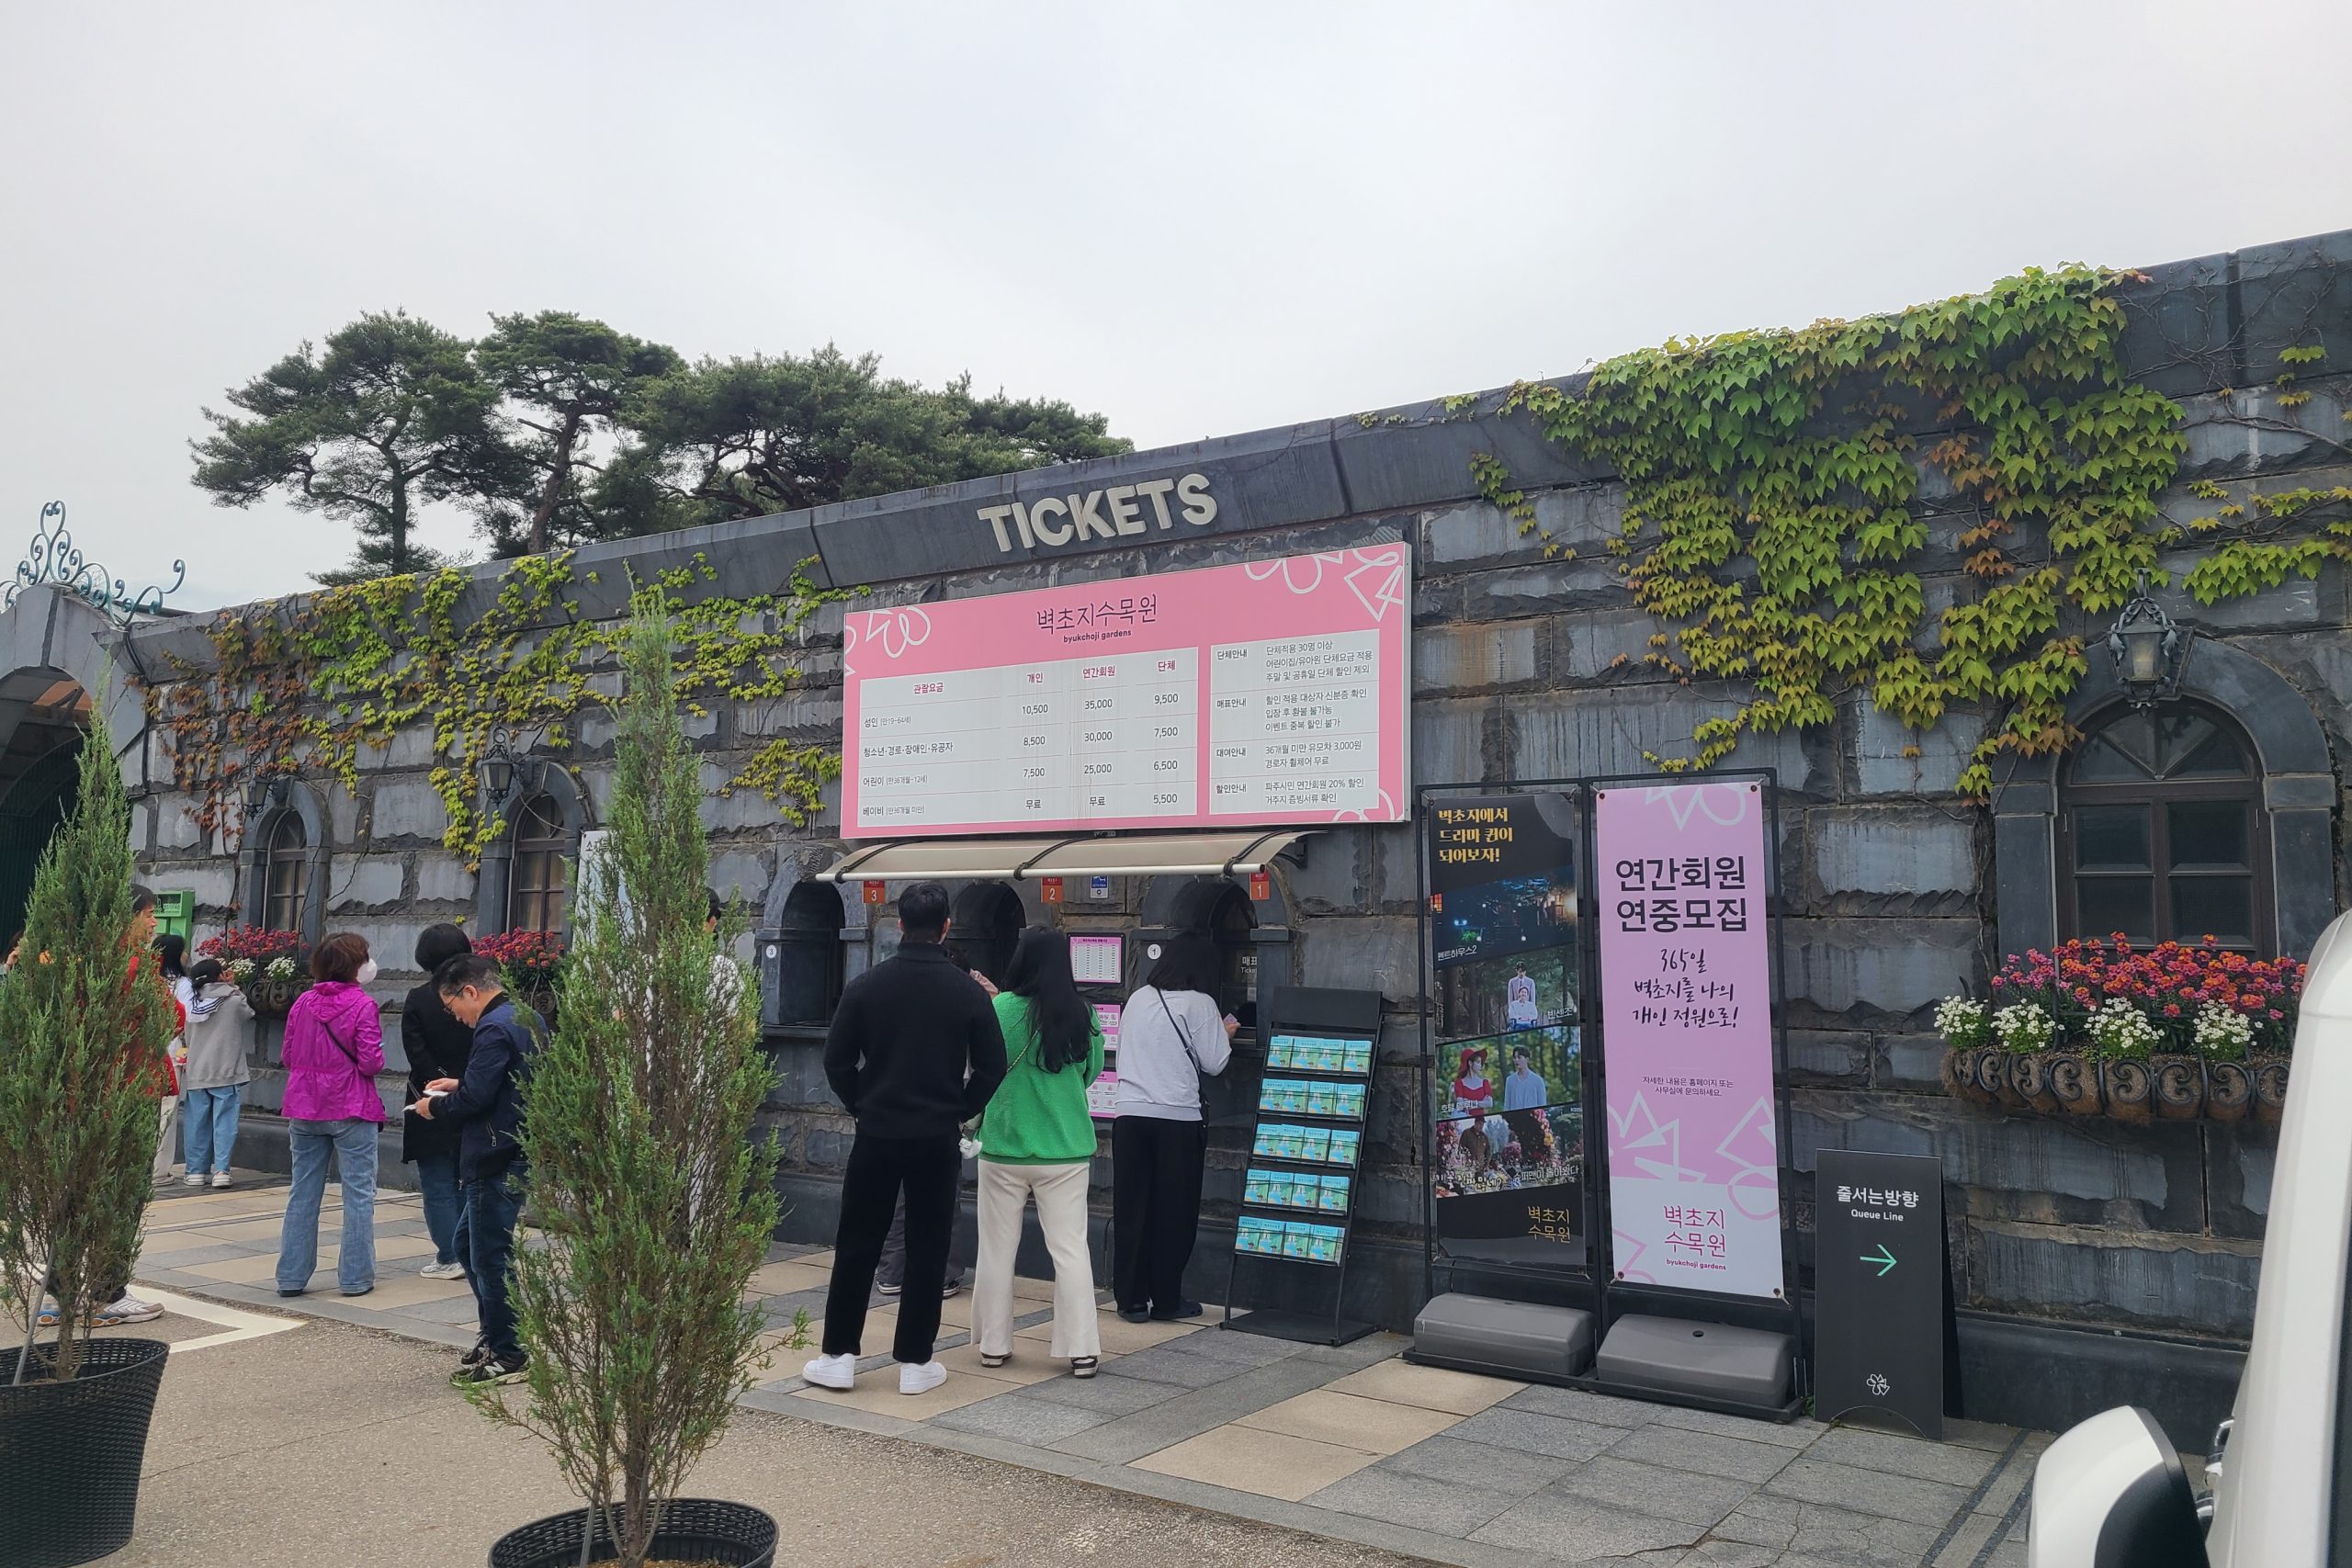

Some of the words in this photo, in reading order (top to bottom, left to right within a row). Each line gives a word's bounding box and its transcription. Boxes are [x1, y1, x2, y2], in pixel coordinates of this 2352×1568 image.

[977, 473, 1218, 553] TICKETS
[1036, 593, 1157, 635] 벽초지수목원
[1063, 631, 1100, 644] byukchoji
[1101, 629, 1132, 640] gardens
[1217, 649, 1248, 660] 단체안내
[1266, 644, 1296, 656] 단체적용
[1298, 642, 1316, 652] 30명
[1317, 640, 1333, 650] 이상
[1324, 652, 1355, 663] 단체요금
[1357, 649, 1373, 660] 적용
[1082, 666, 1115, 679] 연간회원
[1158, 660, 1176, 672] 단체
[1266, 671, 1281, 682] 주말
[1283, 671, 1291, 681] 및
[1293, 669, 1316, 681] 공휴일
[1317, 667, 1334, 678] 단체
[1336, 665, 1352, 677] 할인
[1354, 663, 1370, 674] 제외
[1027, 672, 1044, 683] 개인
[913, 682, 944, 694] 관람요금
[1154, 694, 1179, 705] 9,500
[1216, 698, 1247, 709] 매표안내
[1266, 695, 1281, 706] 할인
[1283, 694, 1298, 705] 적용
[1300, 692, 1323, 703] 대상자
[1325, 690, 1349, 701] 신분증
[1351, 688, 1367, 699] 확인
[1022, 705, 1048, 716] 10,500
[1084, 699, 1113, 710] 35,000
[1265, 709, 1281, 719] 입장
[1283, 707, 1291, 717] 후
[1292, 706, 1307, 717] 환불
[1309, 705, 1332, 716] 불가능
[864, 716, 878, 728] 성인
[1265, 722, 1288, 733] 이벤트
[1290, 721, 1306, 731] 중복
[1307, 718, 1323, 730] 할인
[1325, 717, 1340, 728] 불가
[1084, 731, 1113, 743] 30,000
[1154, 727, 1178, 739] 7,500
[1023, 736, 1046, 748] 8,500
[1265, 745, 1289, 755] 36개월
[1291, 743, 1306, 753] 미만
[1308, 741, 1332, 752] 유모차
[1333, 739, 1362, 750] 3,000원
[1216, 747, 1247, 758] 대여안내
[1153, 760, 1178, 773] 6,500
[1265, 758, 1288, 769] 경로자
[1290, 756, 1312, 768] 휠체어
[1314, 756, 1329, 766] 무료
[1023, 768, 1046, 779] 7,500
[1084, 764, 1112, 775] 25,000
[863, 777, 884, 787] 어린이
[1265, 781, 1295, 792] 파주시민
[1295, 780, 1327, 791] 연간회원
[1328, 779, 1346, 789] 20%
[1347, 777, 1364, 788] 할인
[1216, 784, 1247, 795] 할인안내
[1025, 799, 1042, 810] 무료
[1089, 796, 1106, 807] 무료
[1153, 794, 1178, 806] 5,500
[1265, 795, 1288, 806] 거주지
[1289, 794, 1319, 805] 증빙서류
[1320, 793, 1337, 804] 확인
[863, 807, 884, 817] 베이비
[1438, 807, 1509, 824] 벽초지에서
[1439, 829, 1481, 843] 드라마
[1484, 827, 1513, 843] 퀸이
[1439, 848, 1500, 863] 되어보자!
[1616, 856, 1746, 891] 연간회원
[871, 889, 877, 902] 3
[1049, 887, 1056, 901] 2
[1257, 883, 1262, 897] 1
[1617, 897, 1747, 932] 연중모집
[1661, 948, 1707, 974] 365일
[1634, 977, 1694, 1003] 벽초지를
[1702, 980, 1734, 1001] 나의
[1547, 1007, 1573, 1020] 빈센조
[1632, 1006, 1667, 1027] 개인
[1673, 1007, 1738, 1028] 정원으로!
[1643, 1076, 1664, 1085] 자세한
[1666, 1077, 1687, 1086] 내용은
[1689, 1078, 1717, 1088] 홈페이지
[1719, 1079, 1734, 1088] 또는
[1655, 1087, 1683, 1095] 사무실에
[1837, 1185, 1918, 1208] 줄서는방향
[1527, 1205, 1570, 1225] 벽초지
[1664, 1205, 1724, 1229] 벽초지
[1850, 1209, 1881, 1220] Queue
[1883, 1212, 1904, 1222] Line
[1528, 1224, 1571, 1244] 수목원
[1664, 1231, 1725, 1258] 수목원
[1666, 1258, 1699, 1269] byukchoji
[1699, 1262, 1726, 1270] gardens
